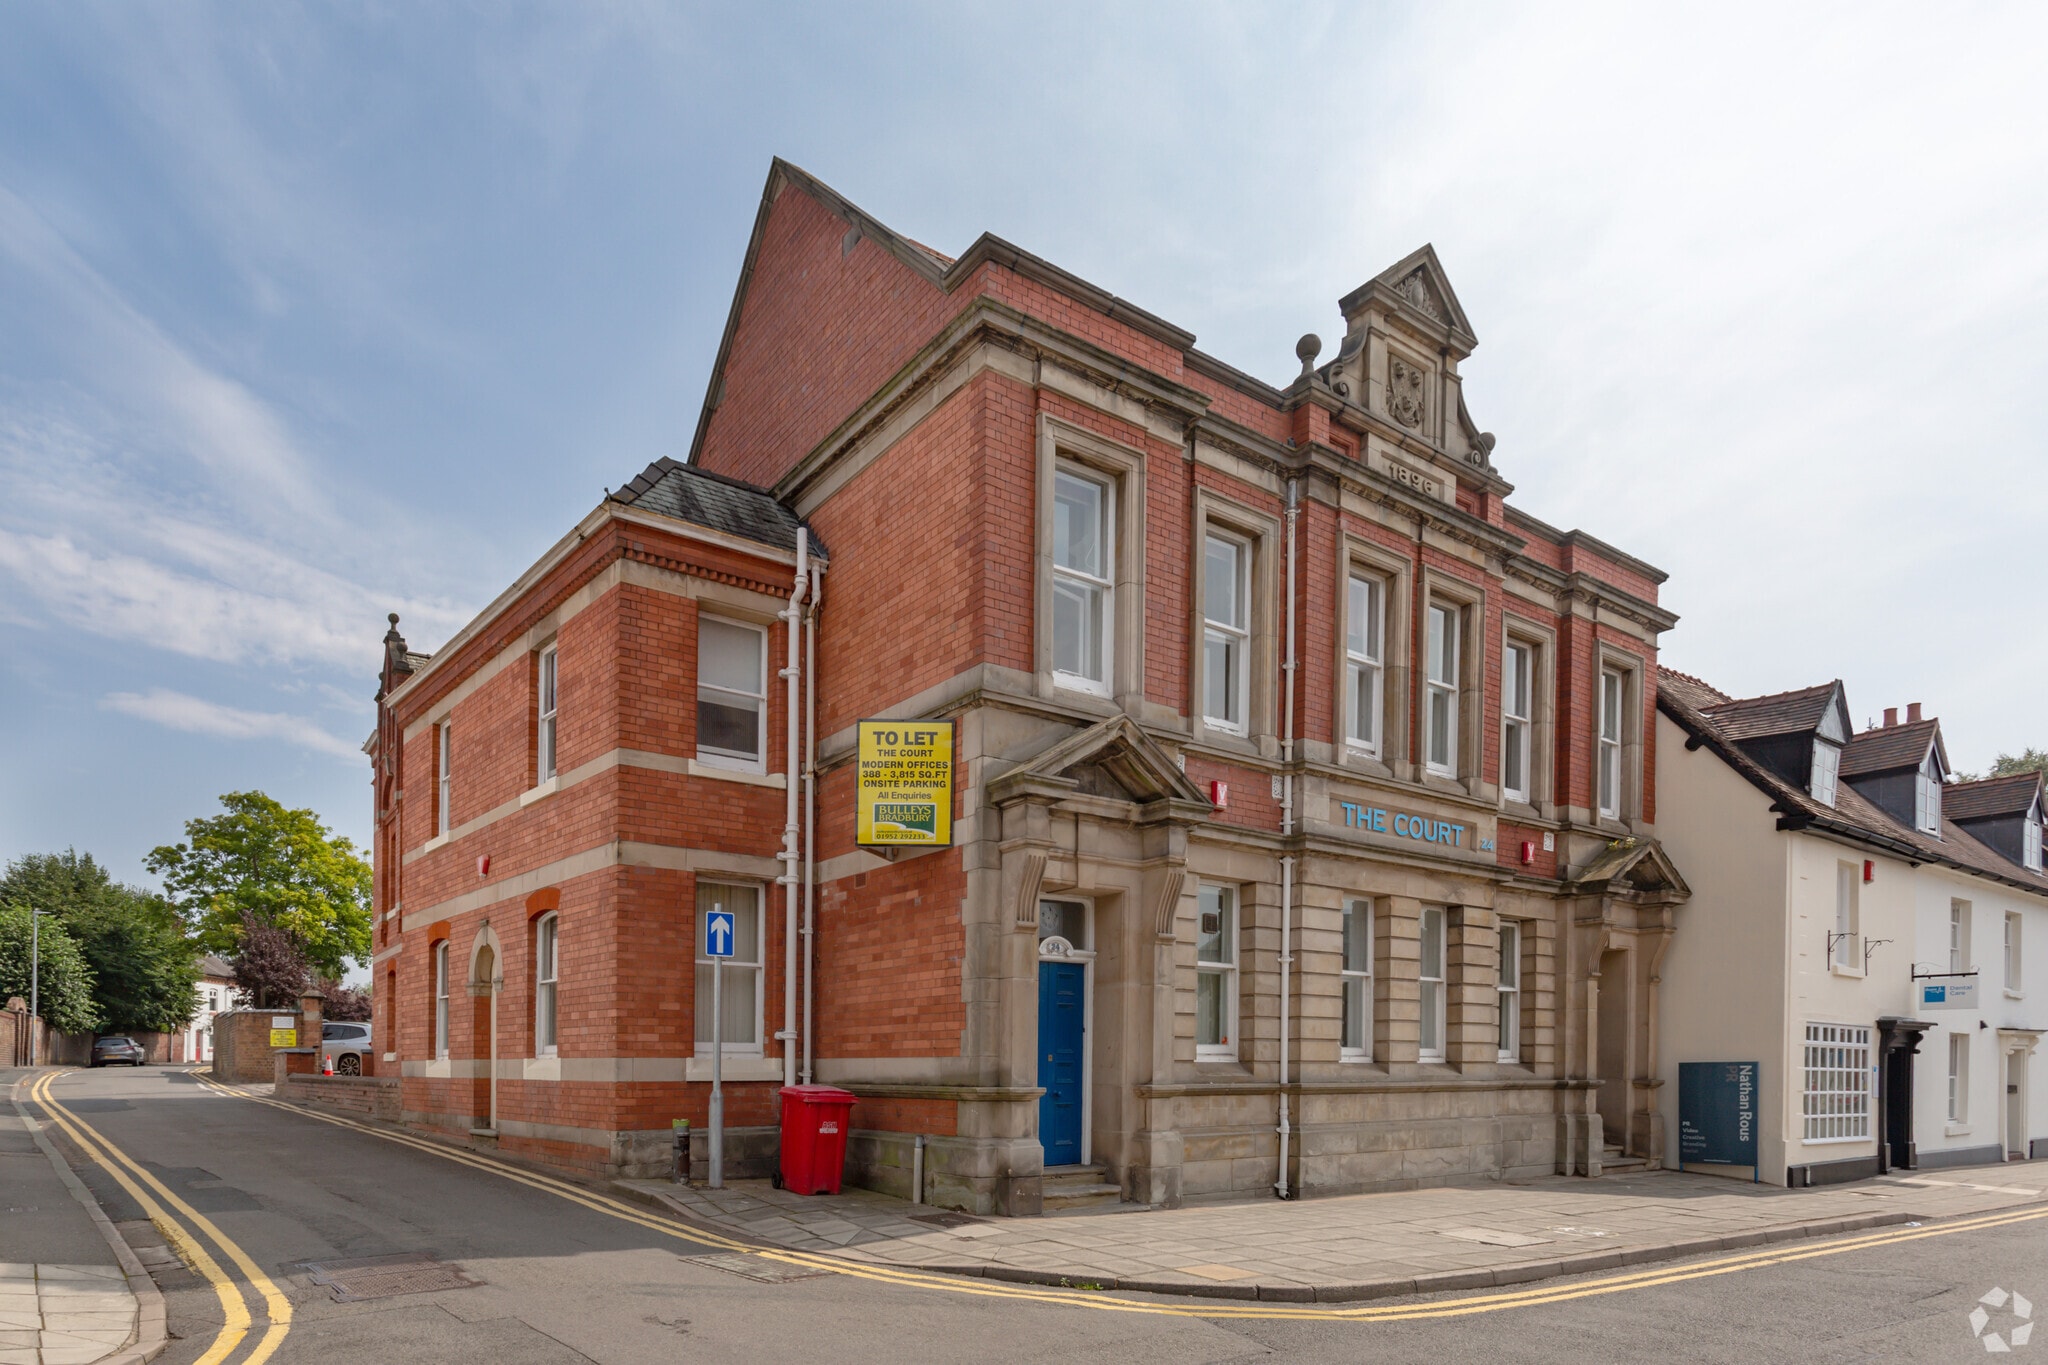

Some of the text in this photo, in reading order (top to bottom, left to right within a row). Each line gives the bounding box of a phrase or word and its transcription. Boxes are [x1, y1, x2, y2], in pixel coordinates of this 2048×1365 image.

[1389, 463, 1433, 495] 1896
[873, 731, 938, 746] TO LET
[877, 749, 934, 757] THE COURT
[862, 761, 948, 769] MODERN OFFICES
[862, 770, 881, 778] 388
[890, 770, 915, 779] 3,815
[918, 770, 947, 778] SQ.FT
[863, 780, 946, 788] ONSITE PARKING
[877, 791, 932, 801] All Enquiries
[879, 805, 931, 815] BULLEYS
[879, 814, 931, 822] BRADBURY
[1341, 801, 1465, 846] THE COURT
[1481, 838, 1495, 851] 24
[1726, 1065, 1738, 1082] PR
[1739, 1065, 1753, 1142] Nathan Rous
